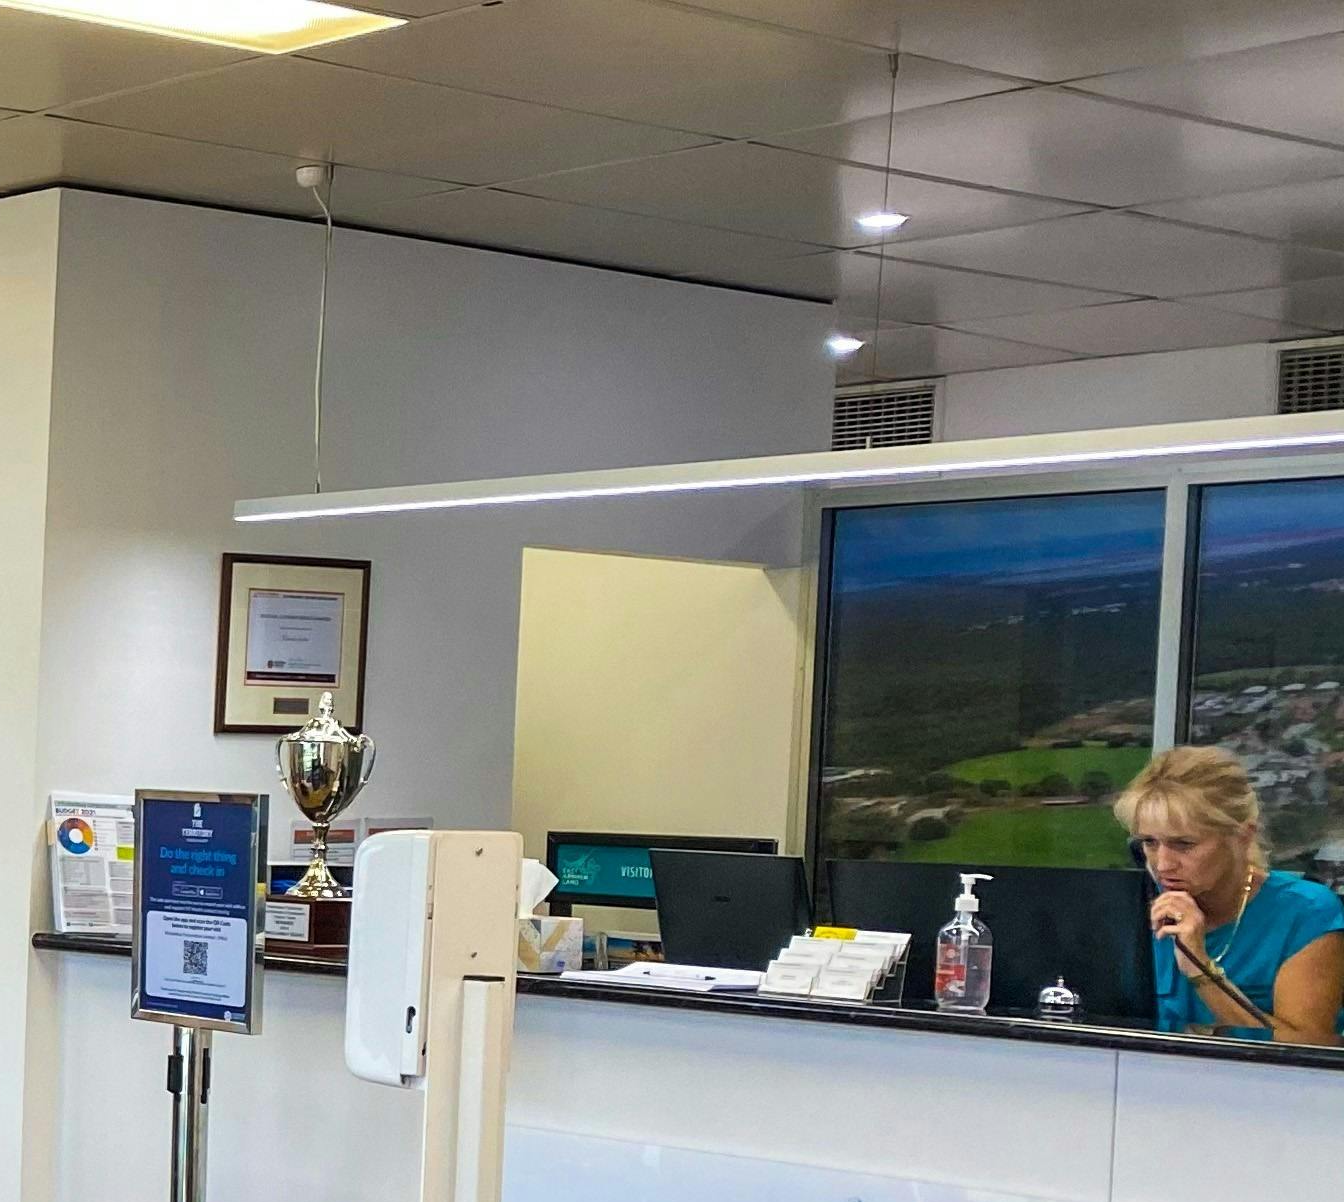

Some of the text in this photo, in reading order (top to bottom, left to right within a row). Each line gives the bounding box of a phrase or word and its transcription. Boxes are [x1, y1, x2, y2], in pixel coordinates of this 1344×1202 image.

[160, 847, 237, 865] Do the right thing
[171, 864, 187, 874] and
[621, 866, 653, 878] VISITO
